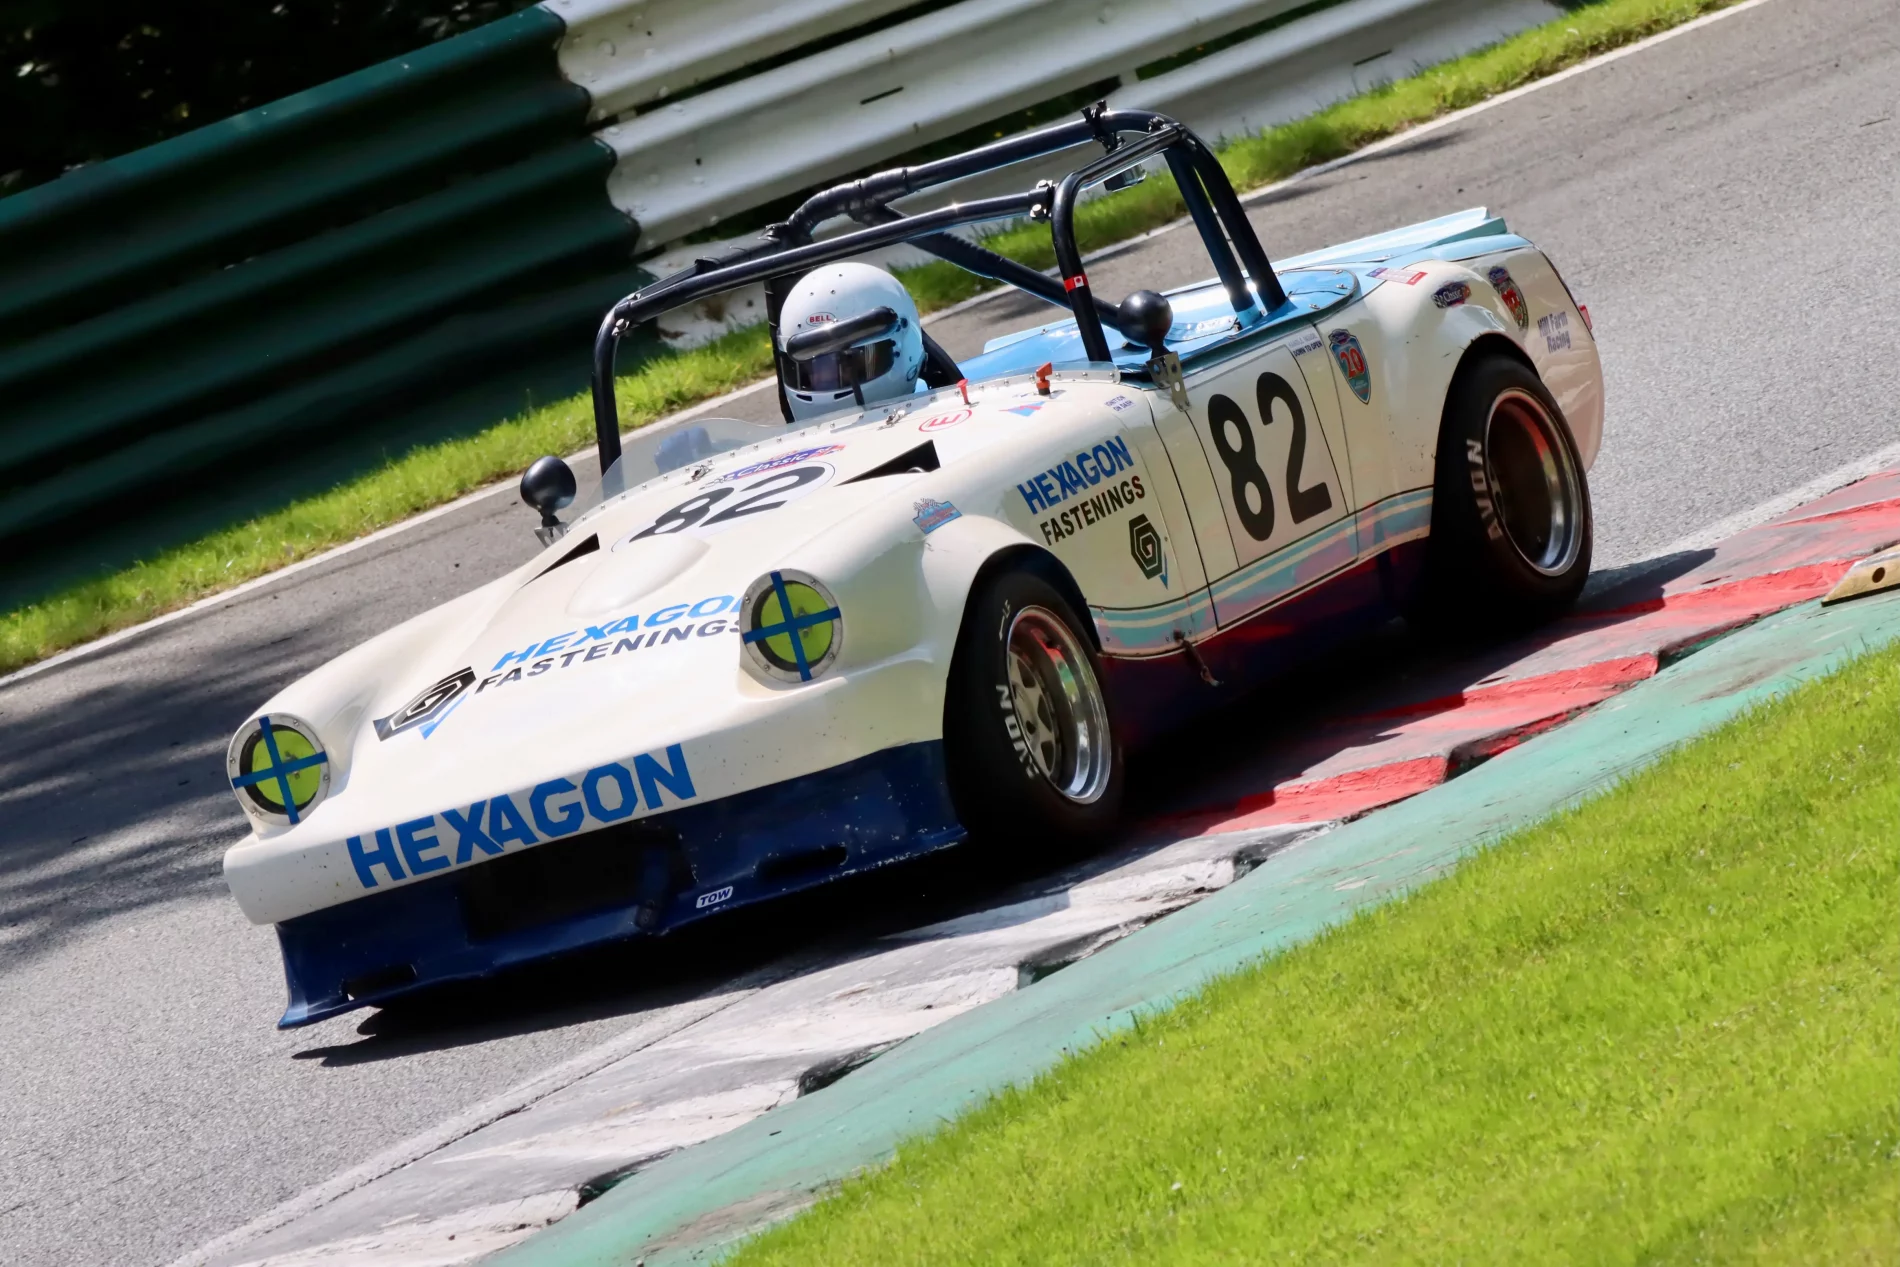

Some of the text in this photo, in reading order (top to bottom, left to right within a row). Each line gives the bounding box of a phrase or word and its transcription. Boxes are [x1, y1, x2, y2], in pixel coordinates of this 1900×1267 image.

[809, 314, 832, 323] BELL
[1549, 311, 1569, 332] Farm
[1293, 346, 1306, 357] DOWN
[1310, 340, 1323, 350] OPEN
[1546, 330, 1571, 354] Racing
[1340, 347, 1365, 378] 20
[928, 413, 962, 427] E
[737, 453, 809, 476] Classic
[1207, 371, 1332, 542] 82
[1016, 435, 1134, 515] HEXAGON
[1466, 438, 1504, 541] AVON
[628, 465, 826, 543] 82
[1039, 475, 1146, 546] FASTENINGS
[995, 684, 1040, 779] AVON
[346, 742, 697, 889] HEXAGON
[700, 888, 731, 906] TOW
